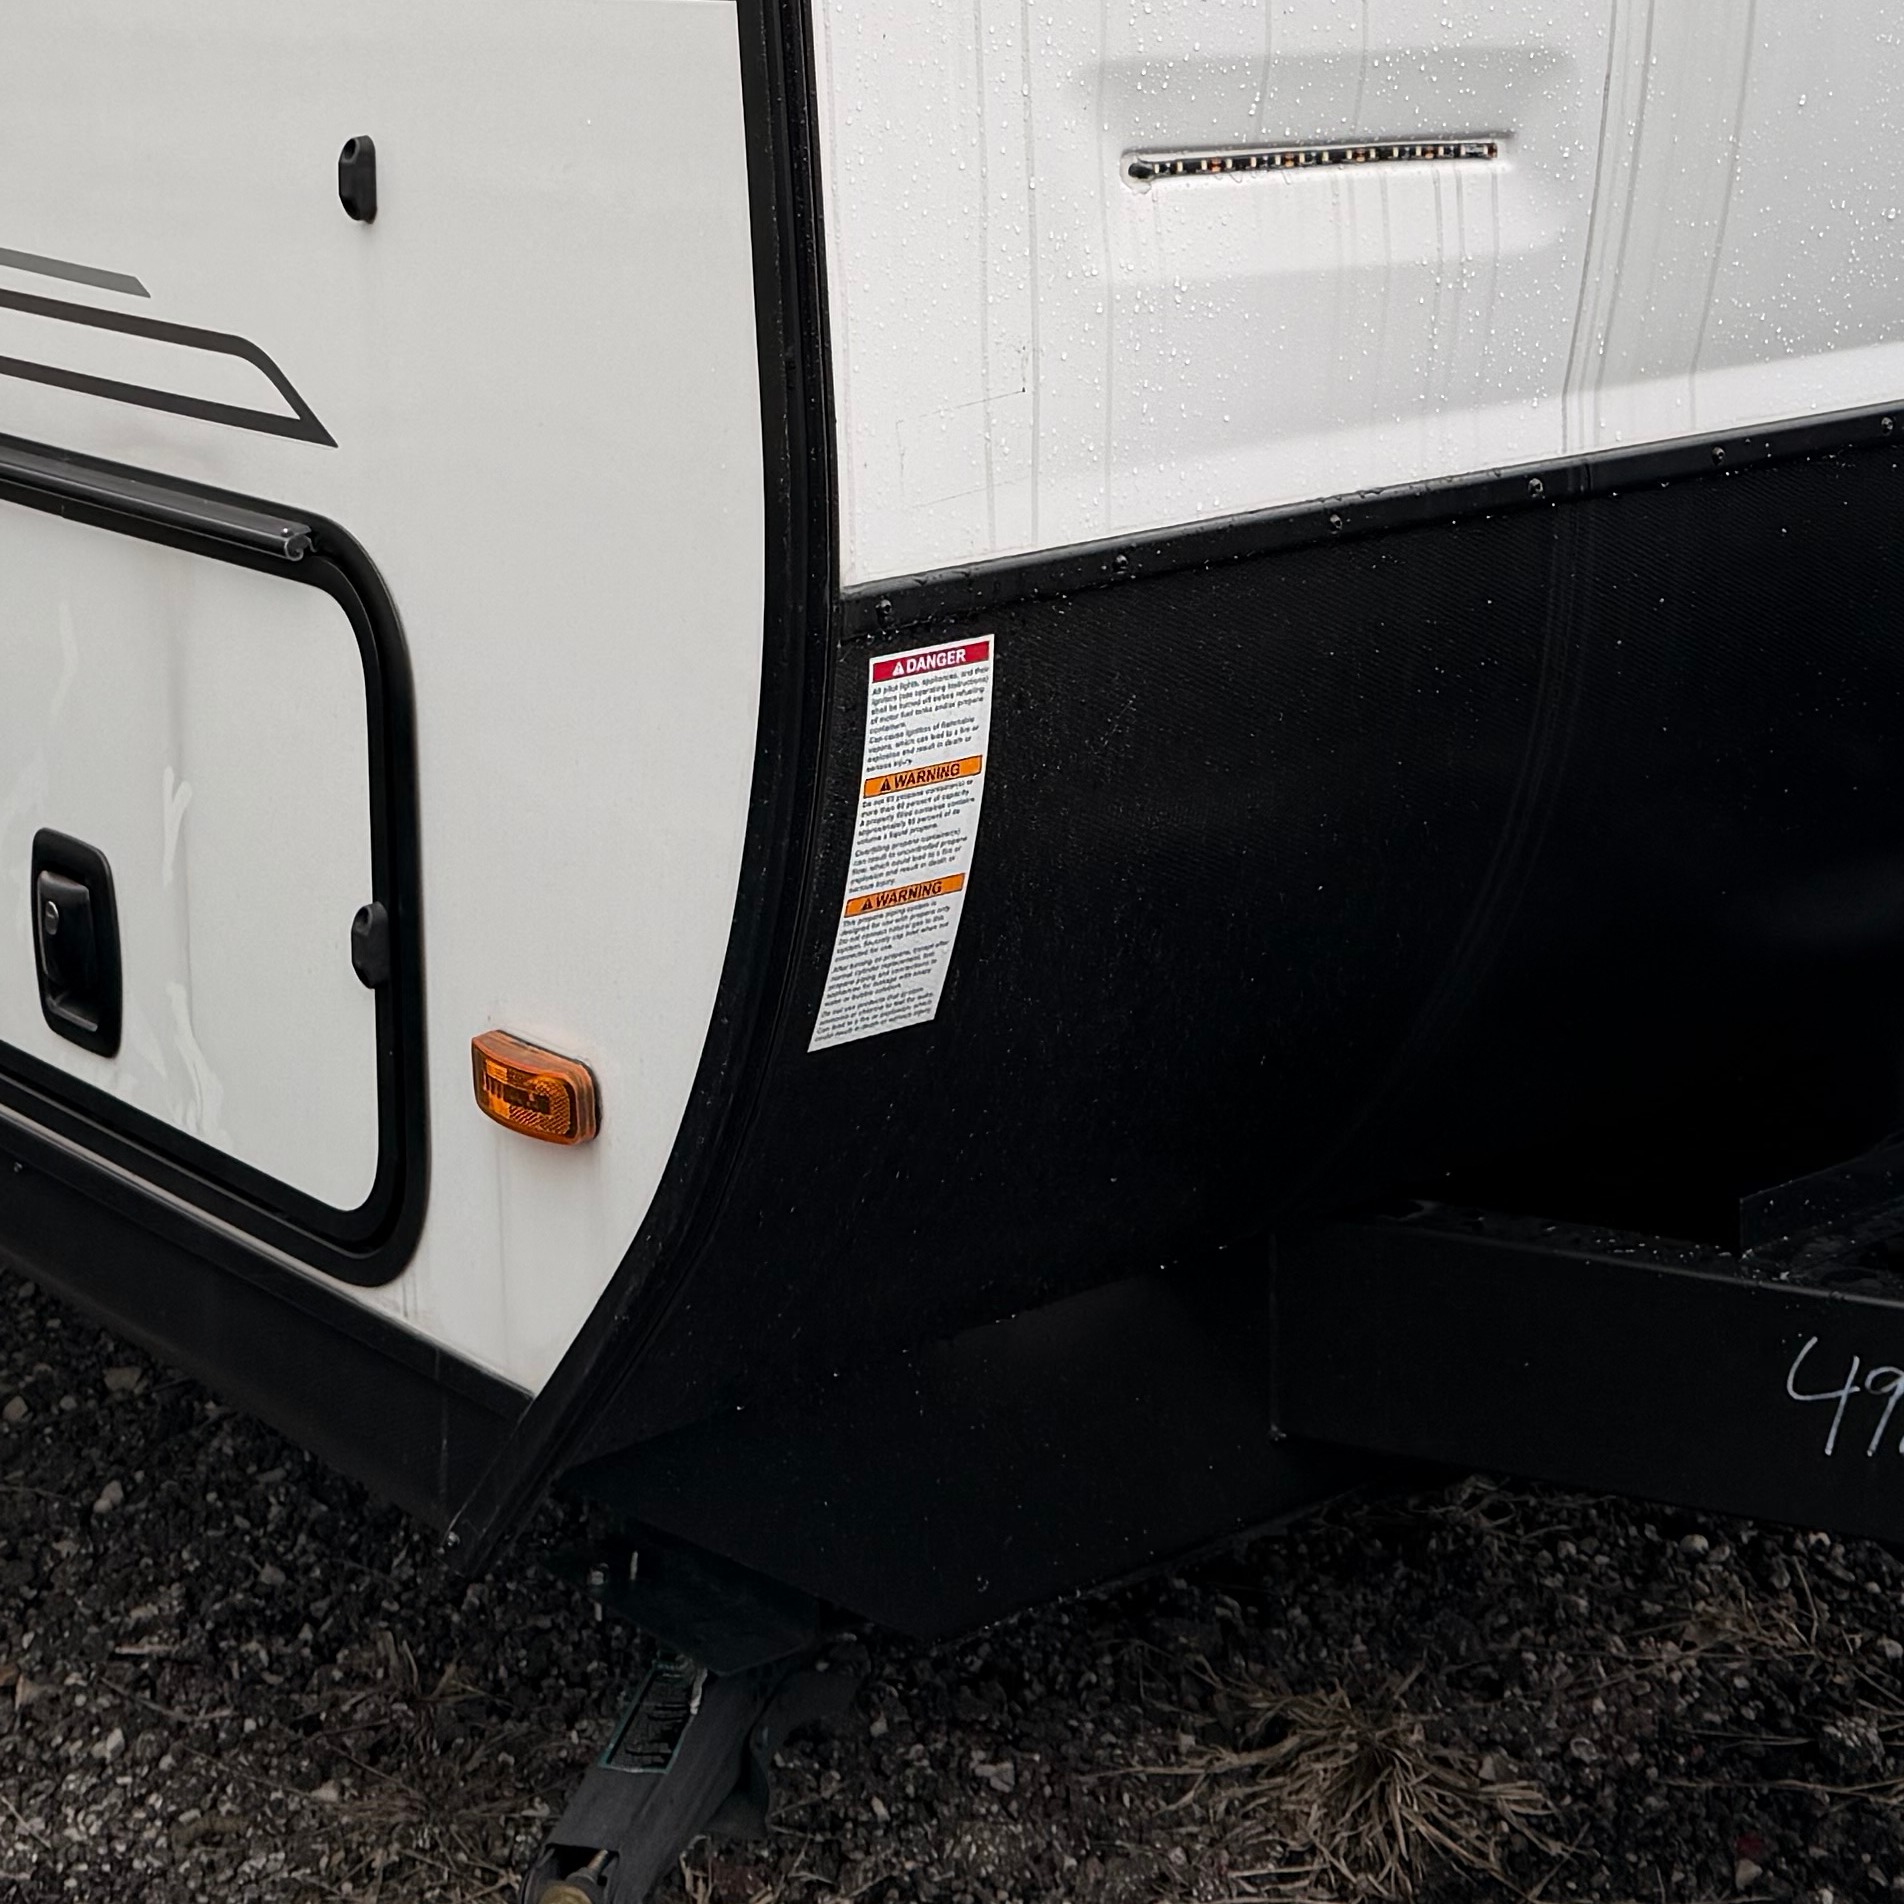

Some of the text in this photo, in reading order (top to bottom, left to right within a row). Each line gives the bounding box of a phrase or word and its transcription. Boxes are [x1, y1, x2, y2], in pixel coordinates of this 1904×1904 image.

[905, 648, 967, 674] DANGER
[895, 763, 960, 788] WARNING
[876, 881, 942, 907] WARNING
